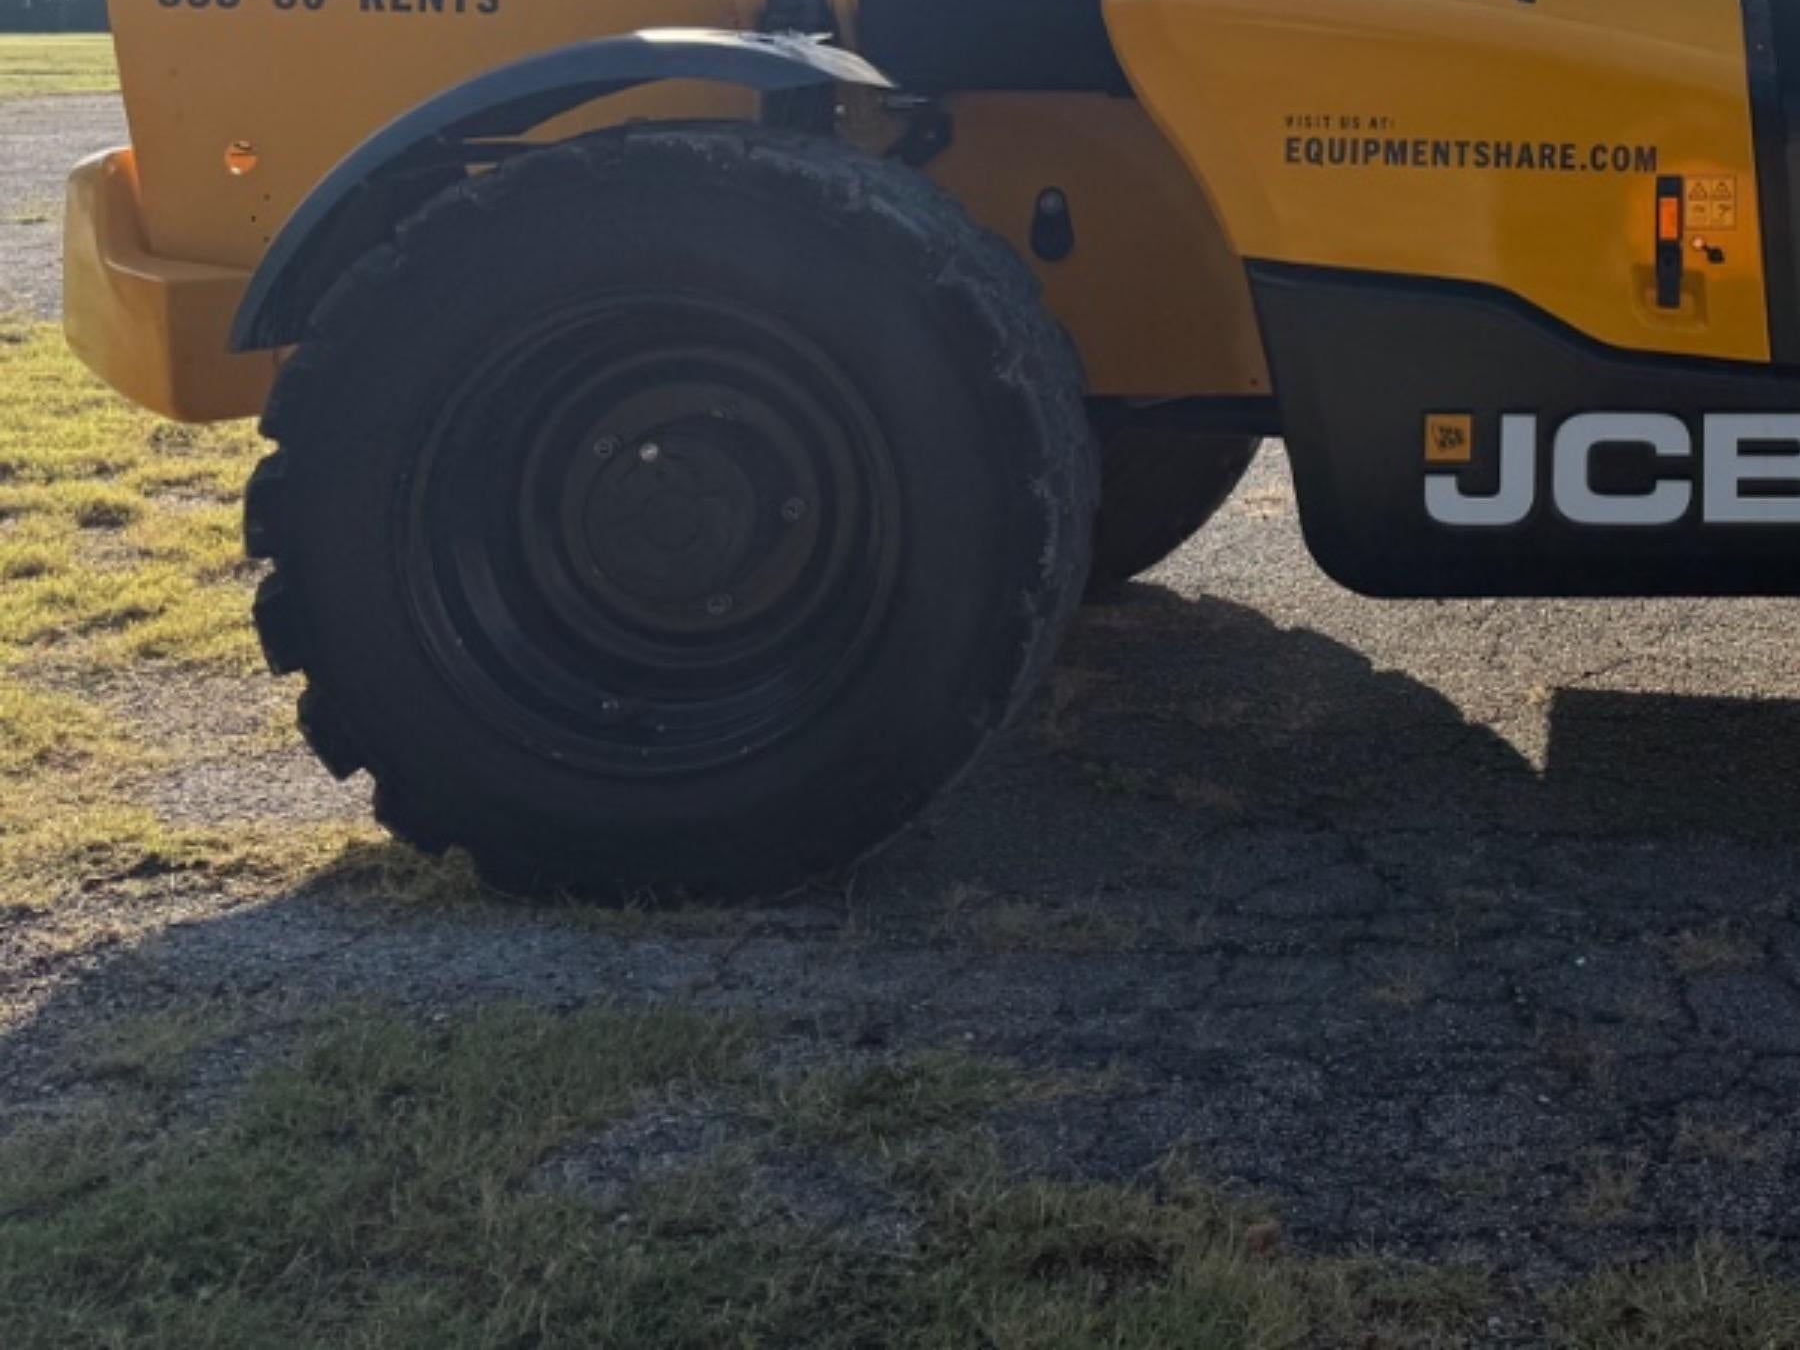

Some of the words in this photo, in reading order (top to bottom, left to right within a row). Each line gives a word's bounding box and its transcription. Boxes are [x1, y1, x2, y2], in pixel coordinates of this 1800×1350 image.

[1285, 115, 1331, 129] VISIT
[1340, 116, 1360, 129] US
[1285, 137, 1657, 172] EQUIPMENTSHARE.COM
